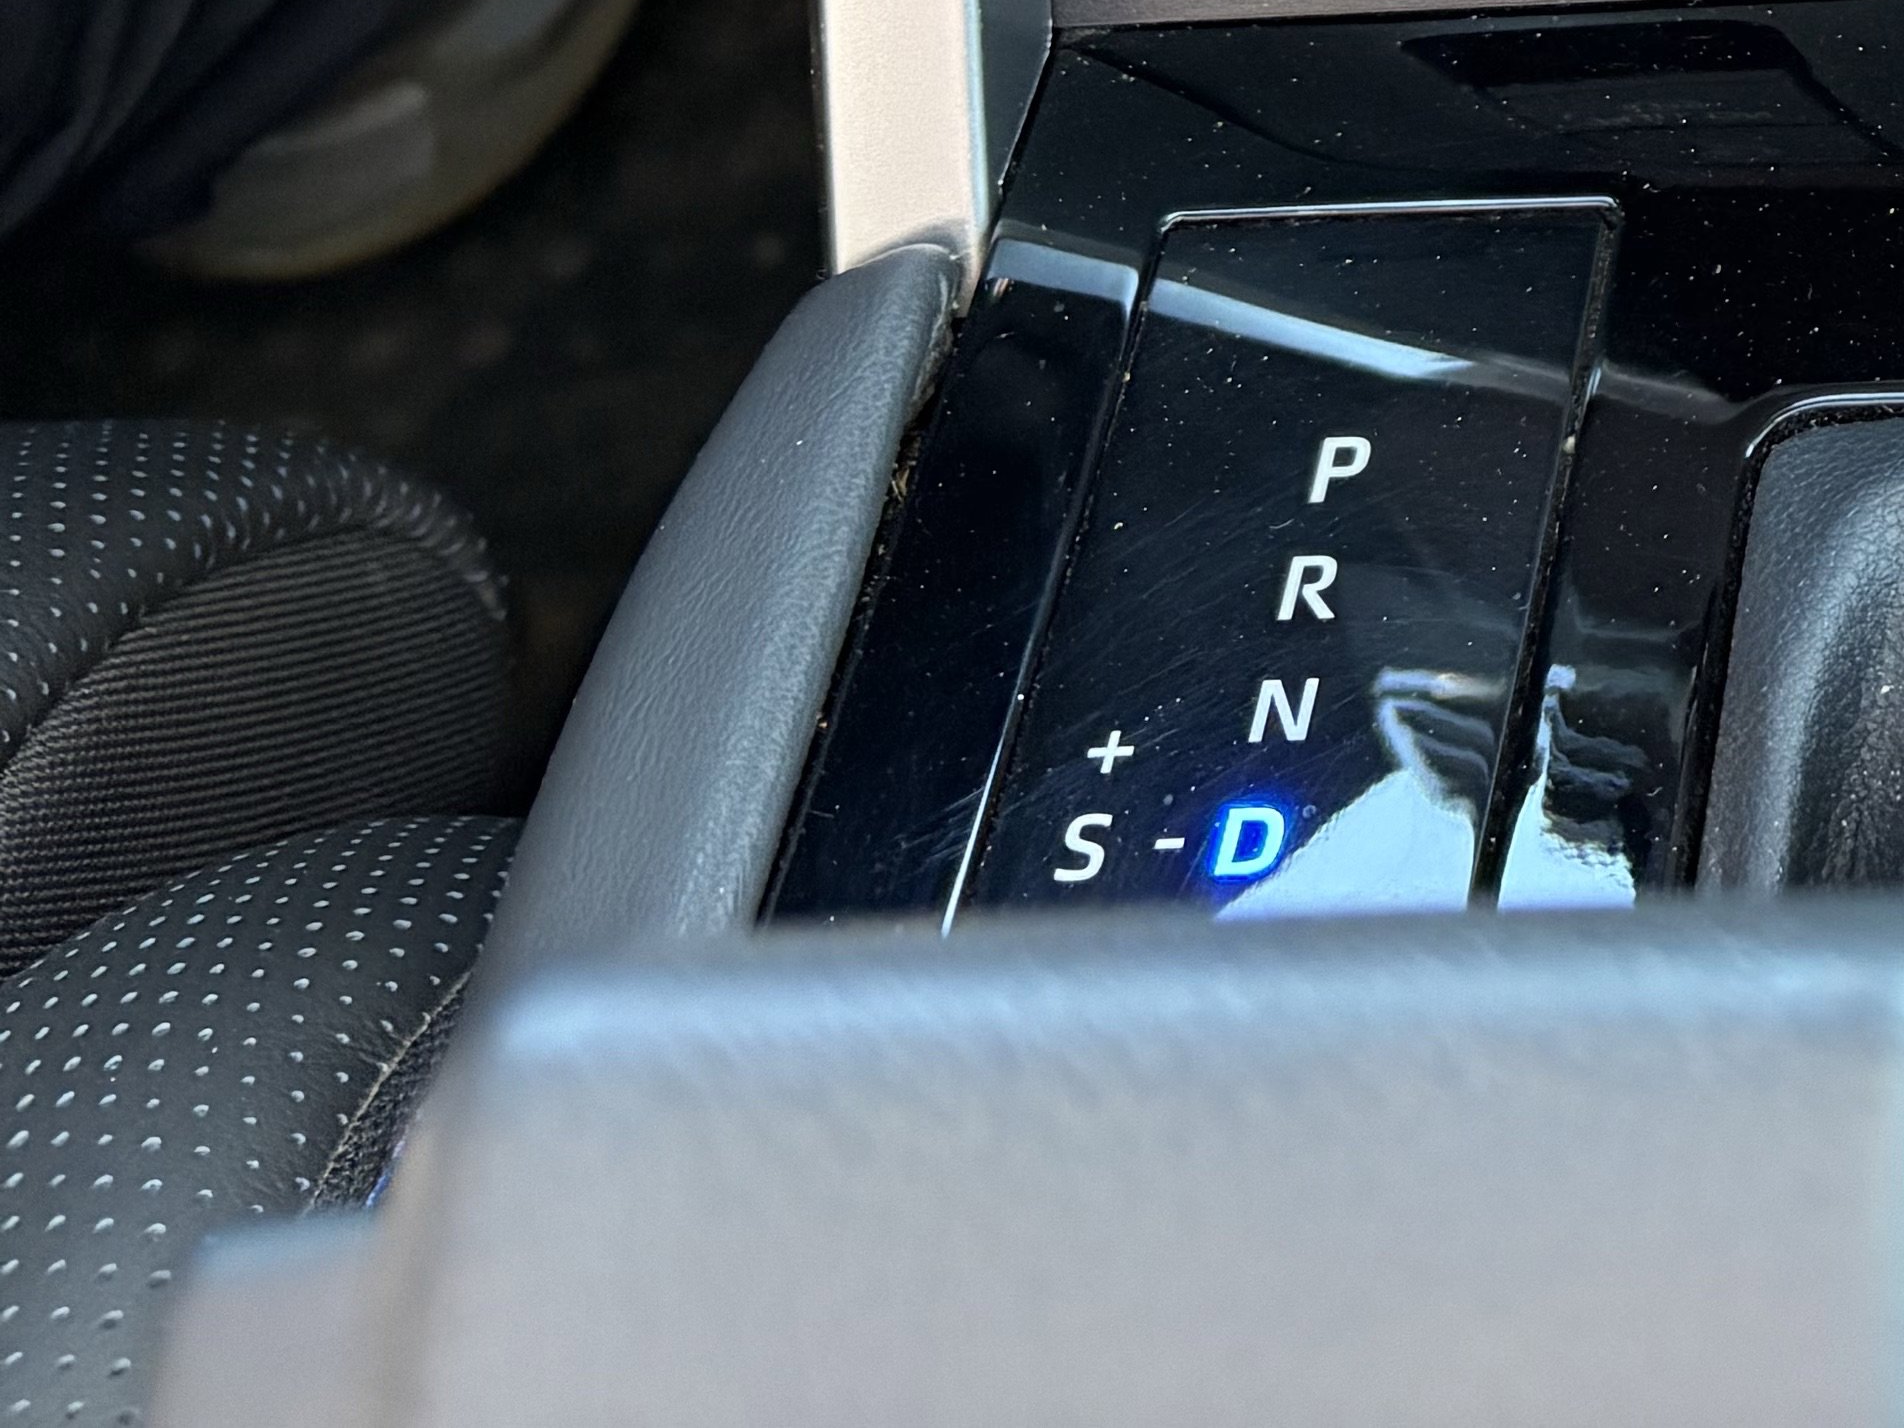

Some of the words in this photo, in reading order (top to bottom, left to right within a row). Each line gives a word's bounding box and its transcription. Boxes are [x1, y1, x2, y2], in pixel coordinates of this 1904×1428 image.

[1308, 436, 1372, 504] P
[1277, 555, 1338, 621] R
[1247, 677, 1320, 743] N
[1053, 812, 1113, 882] S
[1212, 806, 1286, 878] D
